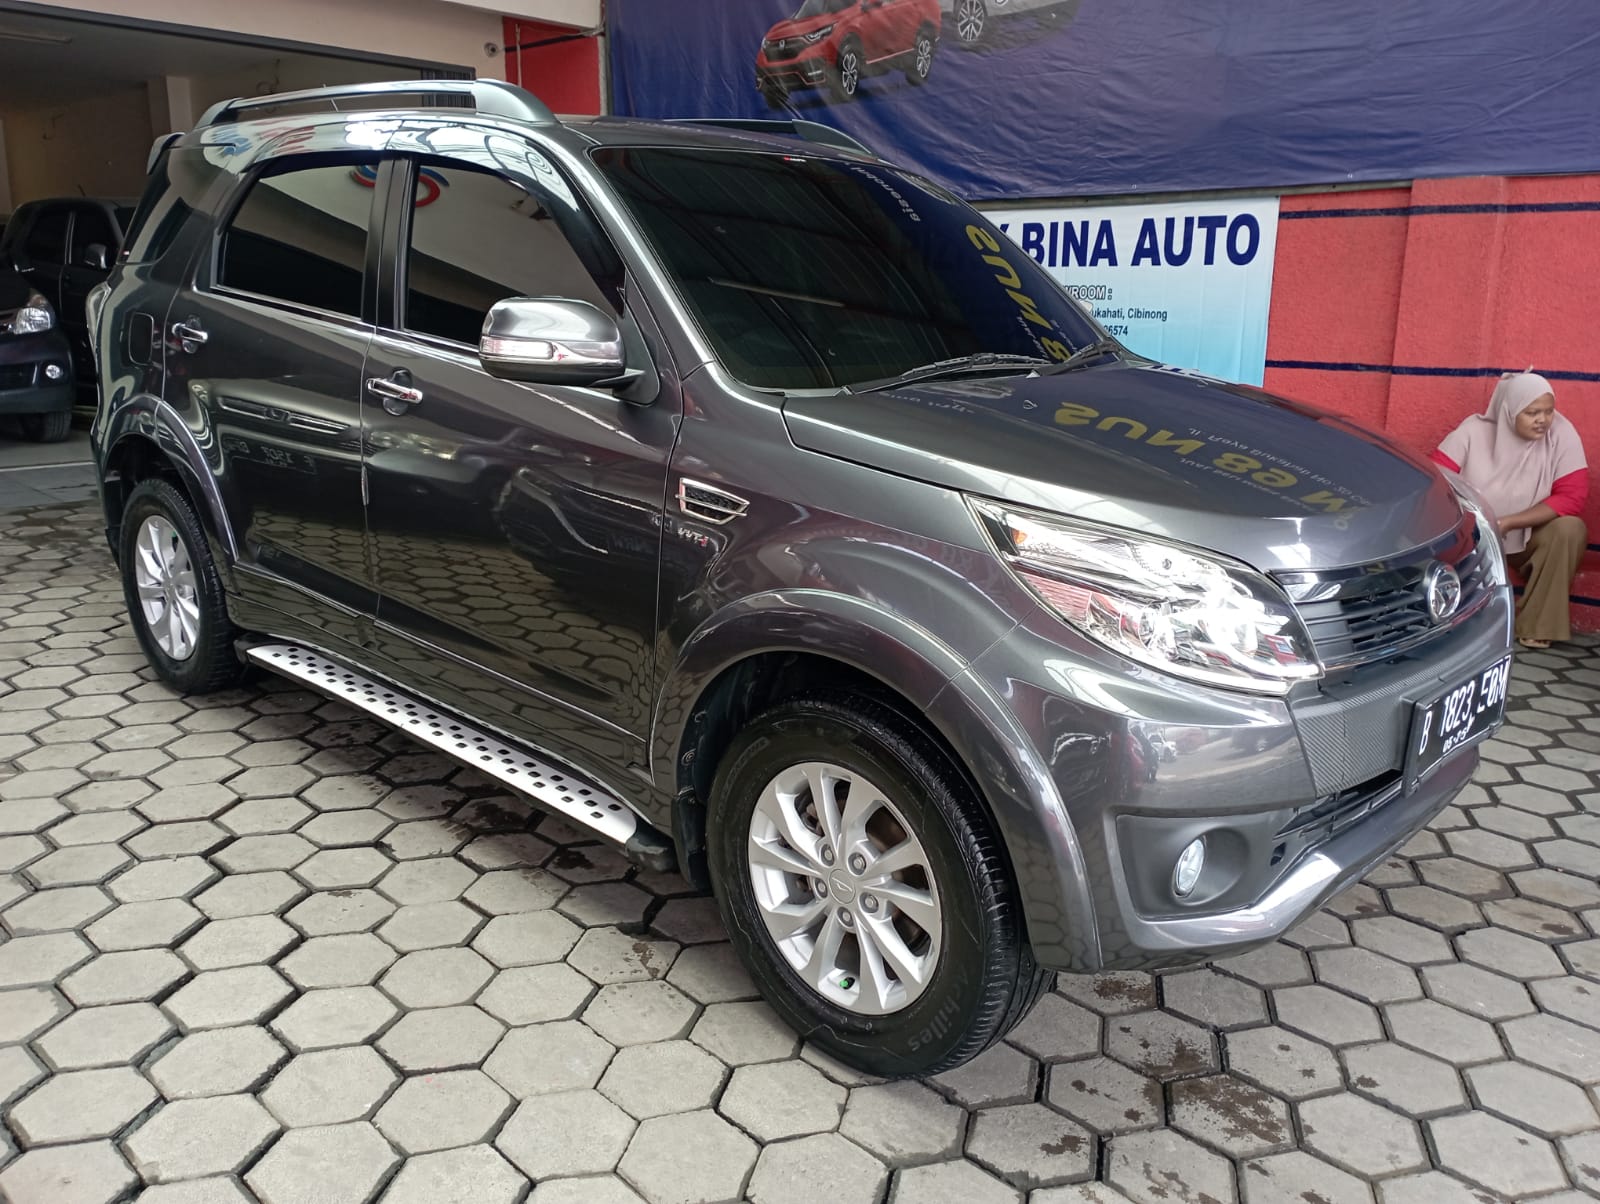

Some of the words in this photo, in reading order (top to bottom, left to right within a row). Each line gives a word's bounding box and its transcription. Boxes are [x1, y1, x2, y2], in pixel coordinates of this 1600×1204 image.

[1021, 218, 1118, 267] BINA
[1131, 213, 1260, 267] AUTO
[1092, 308, 1125, 320] ukahati,
[1127, 308, 1168, 322] Cibinong
[1418, 710, 1433, 756] B
[1440, 679, 1476, 737] 1823
